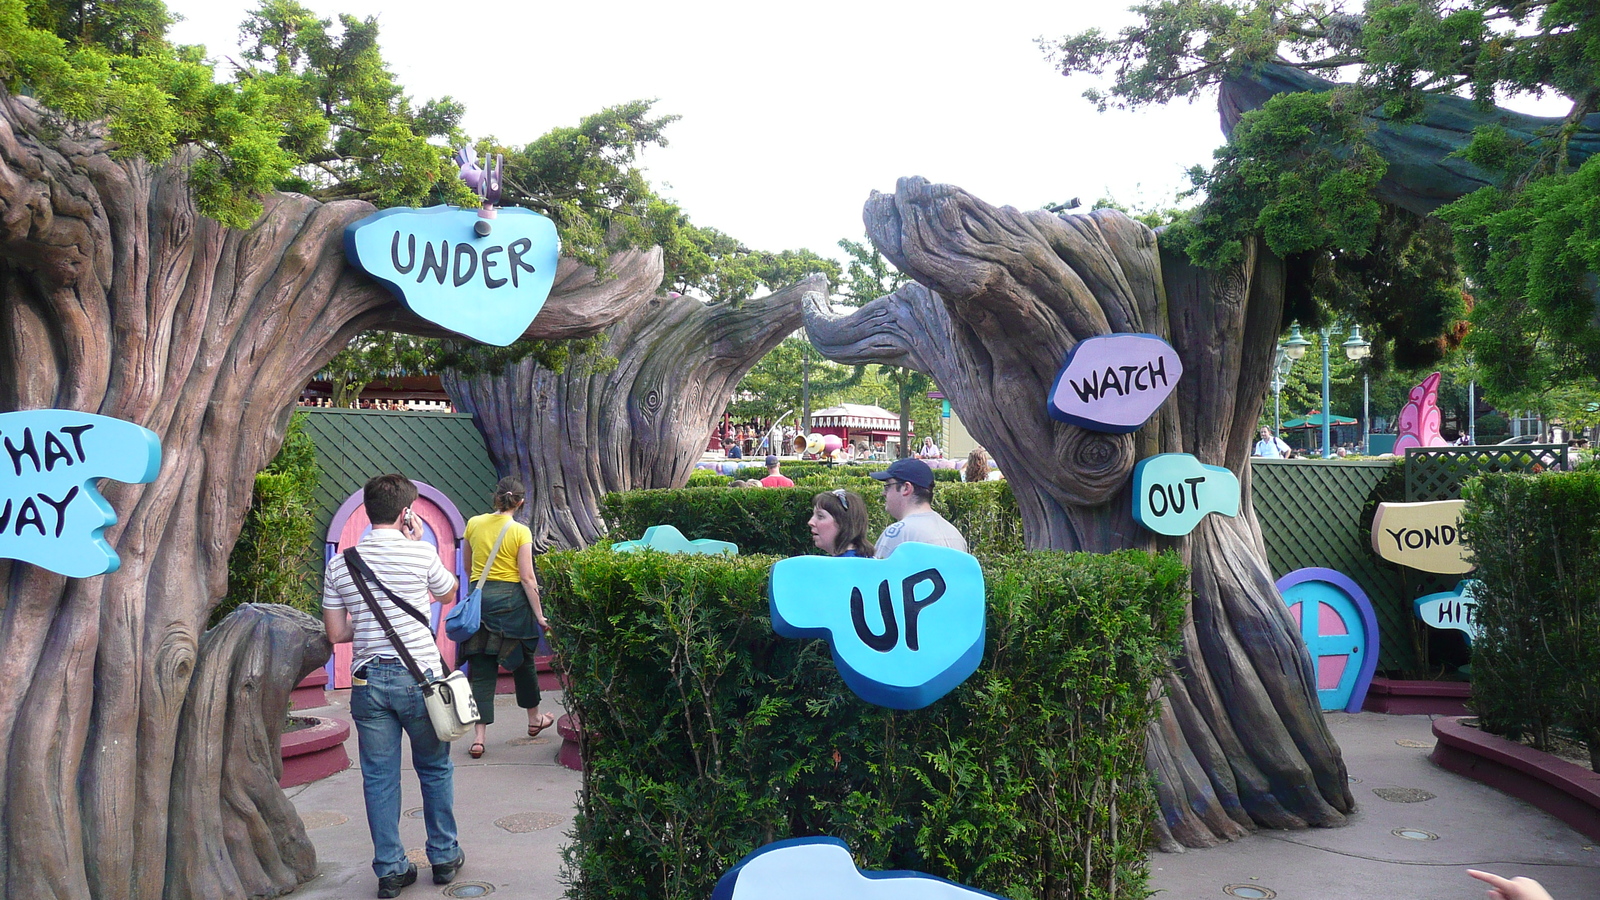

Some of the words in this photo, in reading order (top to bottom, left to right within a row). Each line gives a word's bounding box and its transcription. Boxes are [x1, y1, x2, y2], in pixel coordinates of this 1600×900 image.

[391, 230, 535, 289] UNDER
[1069, 356, 1168, 403] WATCH
[0, 424, 95, 477] HAT
[1149, 477, 1205, 517] OUT
[850, 568, 946, 652] UP
